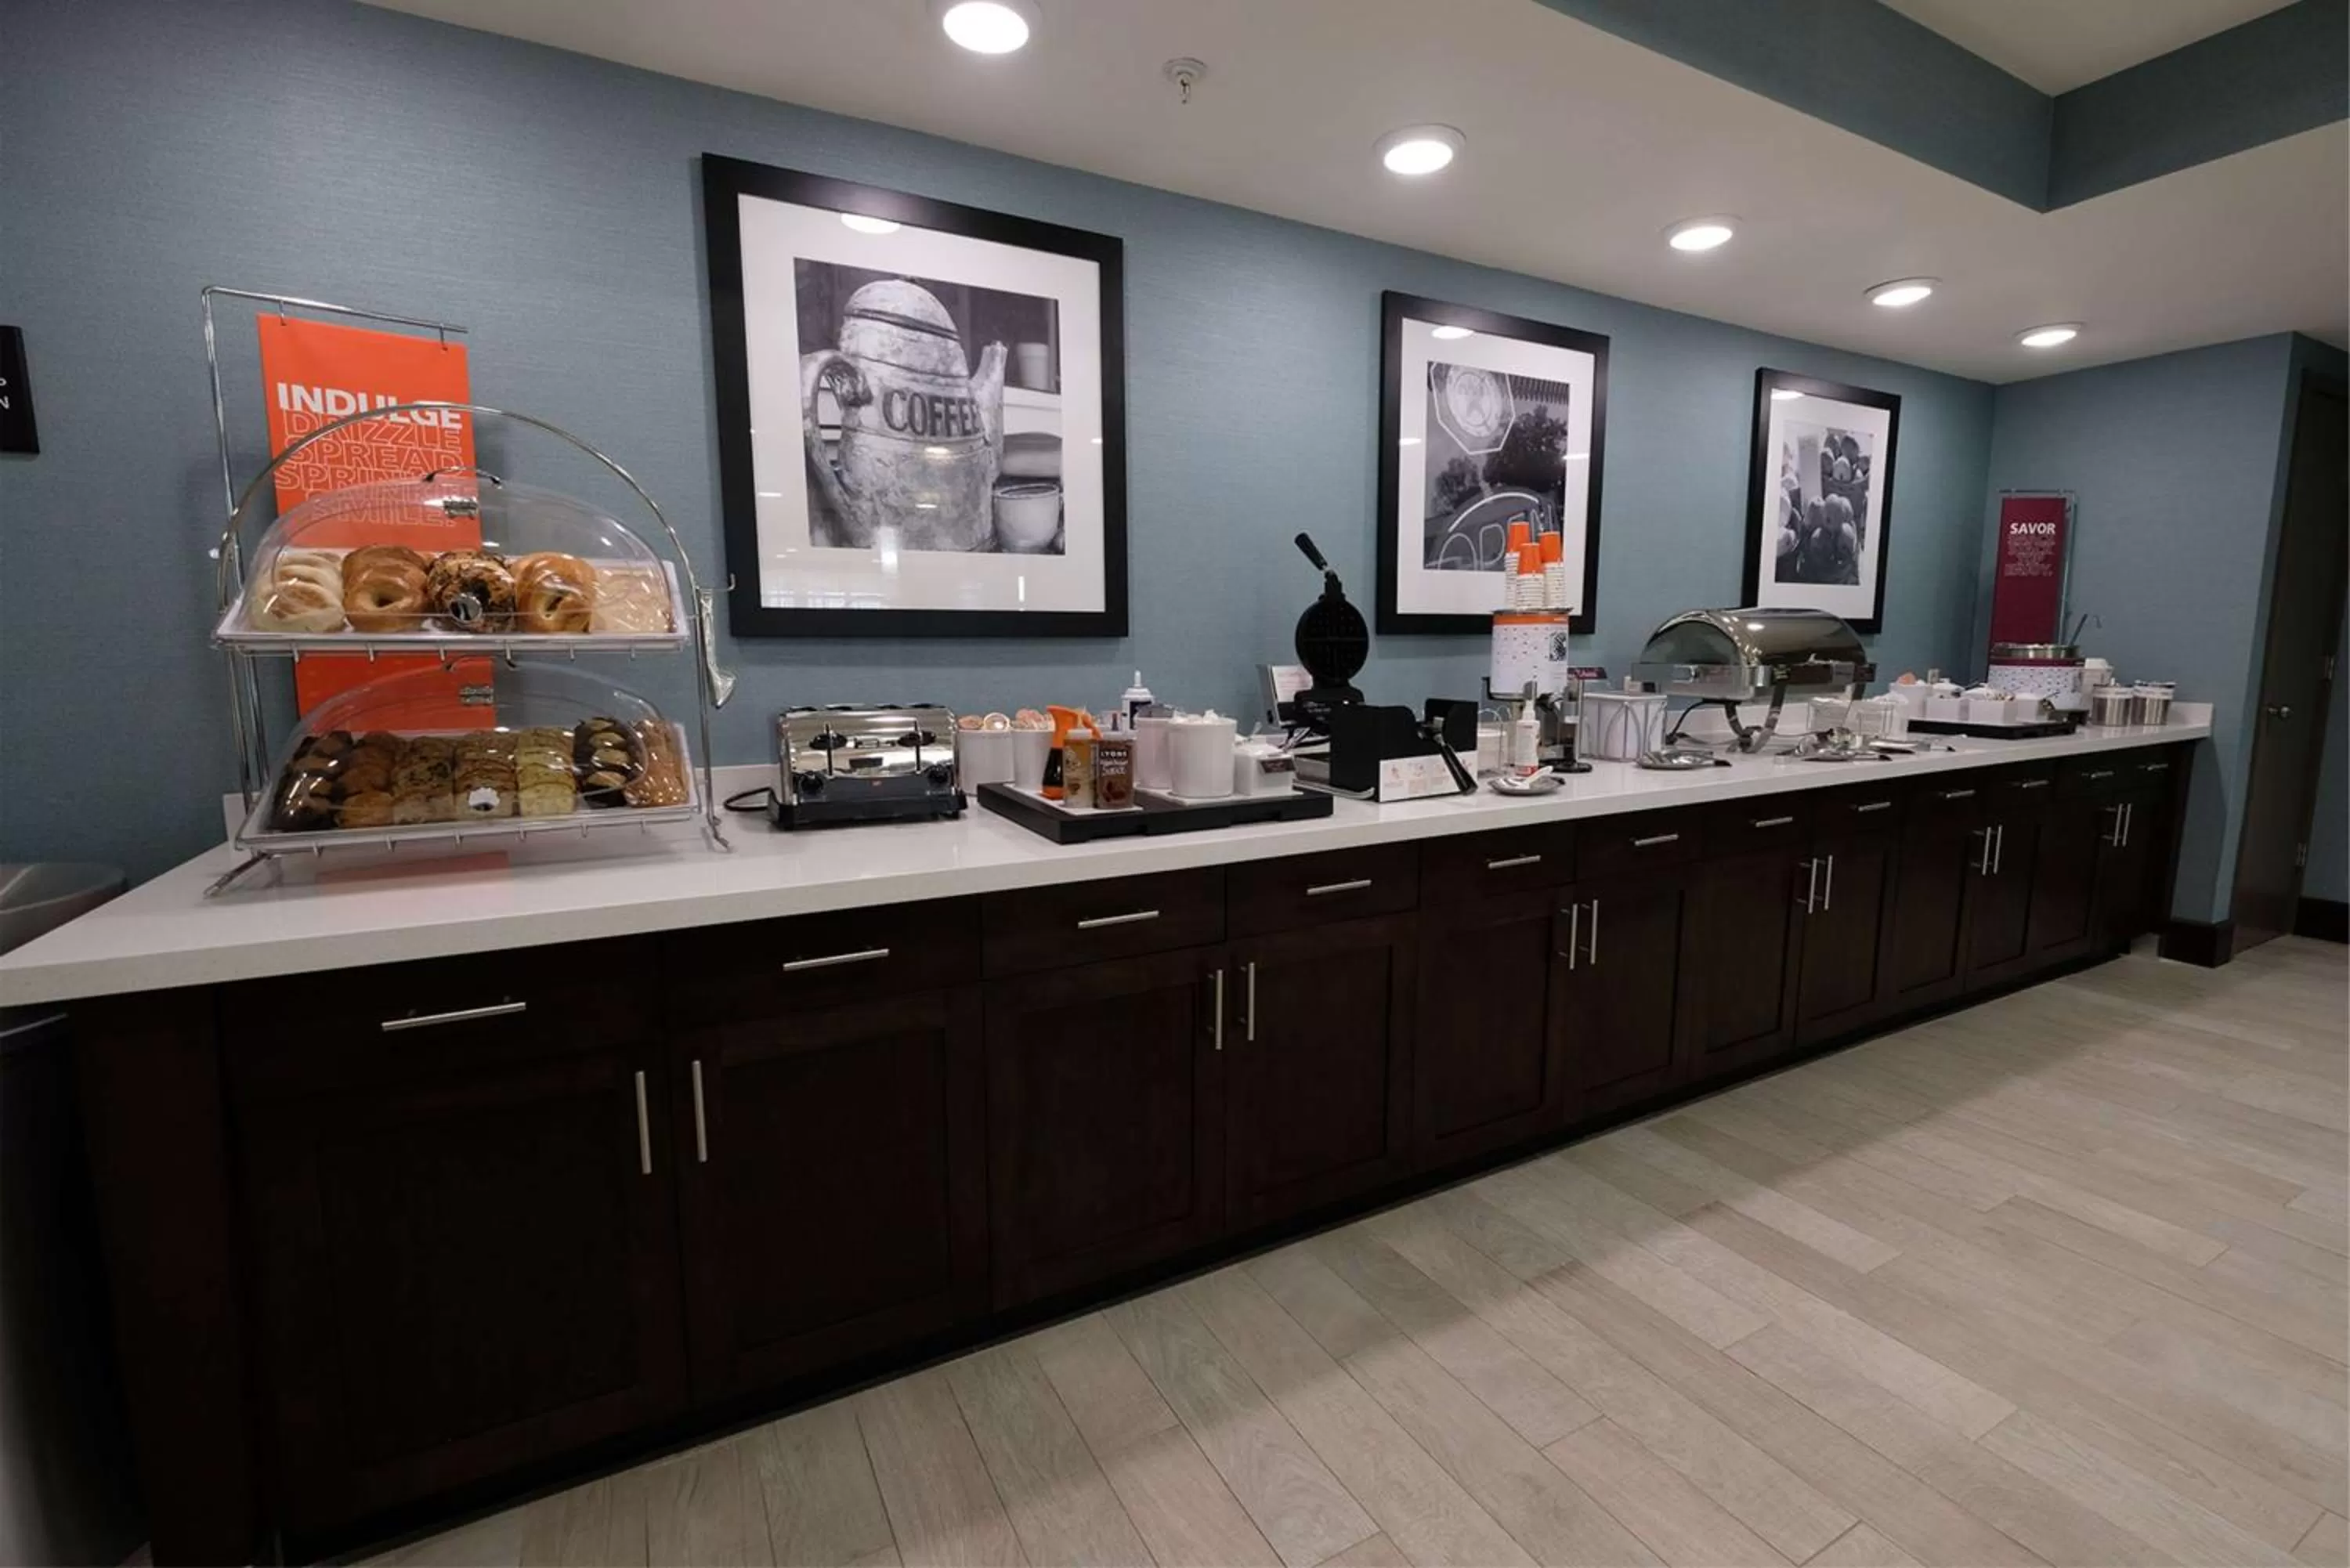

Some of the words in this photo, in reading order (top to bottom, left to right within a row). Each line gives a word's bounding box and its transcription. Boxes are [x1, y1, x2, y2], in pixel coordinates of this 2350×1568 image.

[277, 382, 462, 429] INDULGE
[284, 435, 464, 476] SPREAD
[2009, 522, 2055, 534] SAVOR
